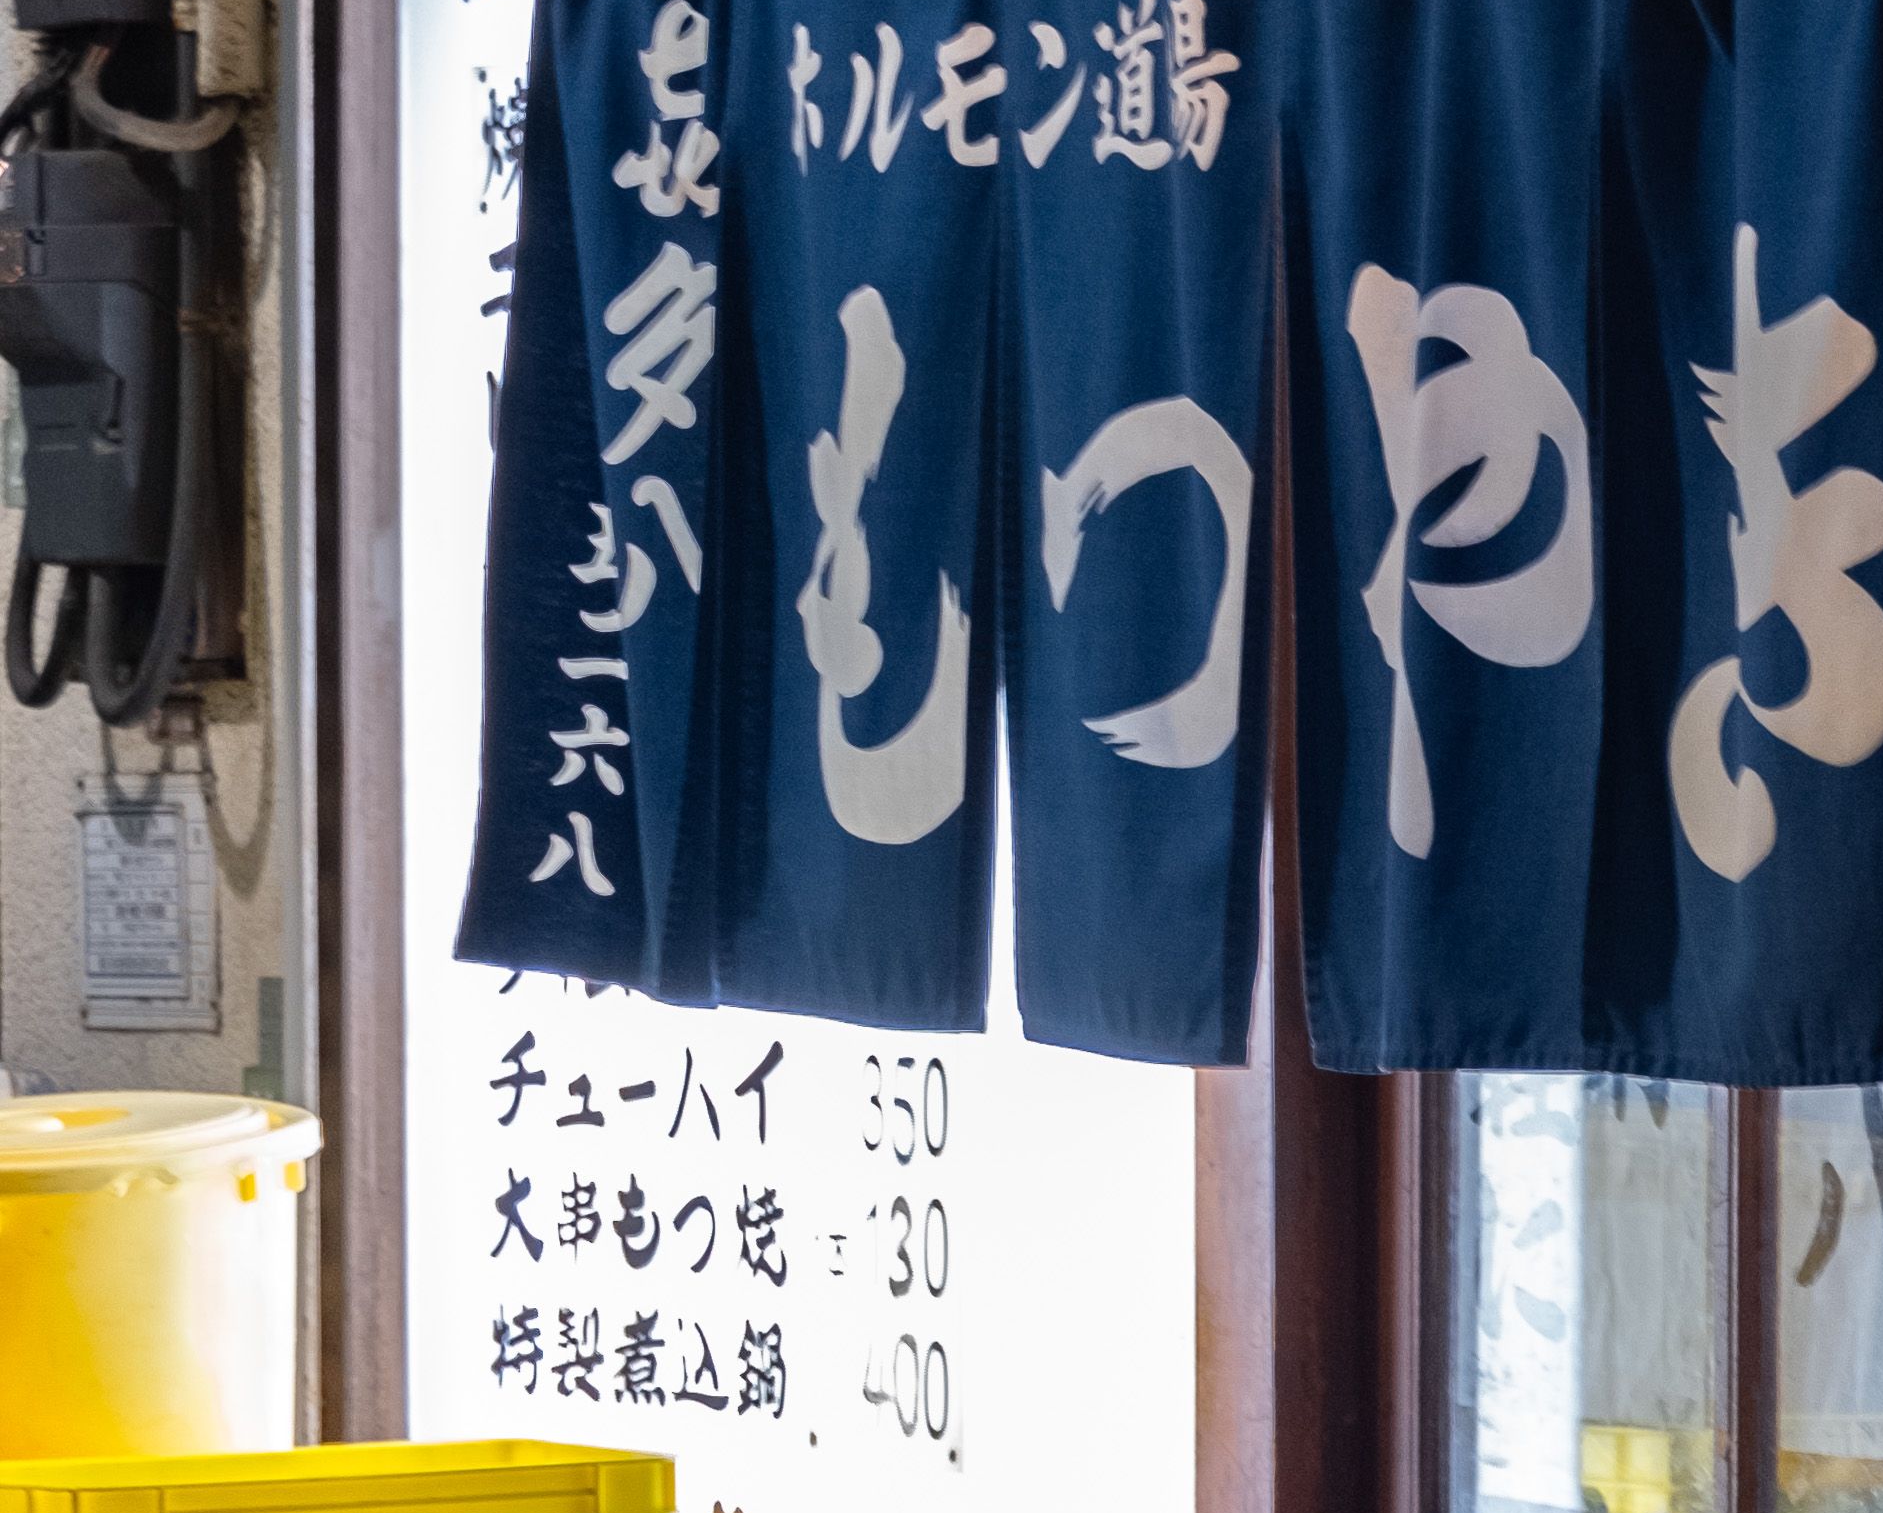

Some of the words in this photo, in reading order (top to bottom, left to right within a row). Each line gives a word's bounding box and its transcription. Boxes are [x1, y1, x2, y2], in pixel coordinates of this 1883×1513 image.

[490, 1030, 784, 1144] チューハイ
[863, 1054, 948, 1165] 350
[490, 1169, 789, 1287] 大串もつ焼
[489, 1305, 789, 1421] 特製煮込鍋
